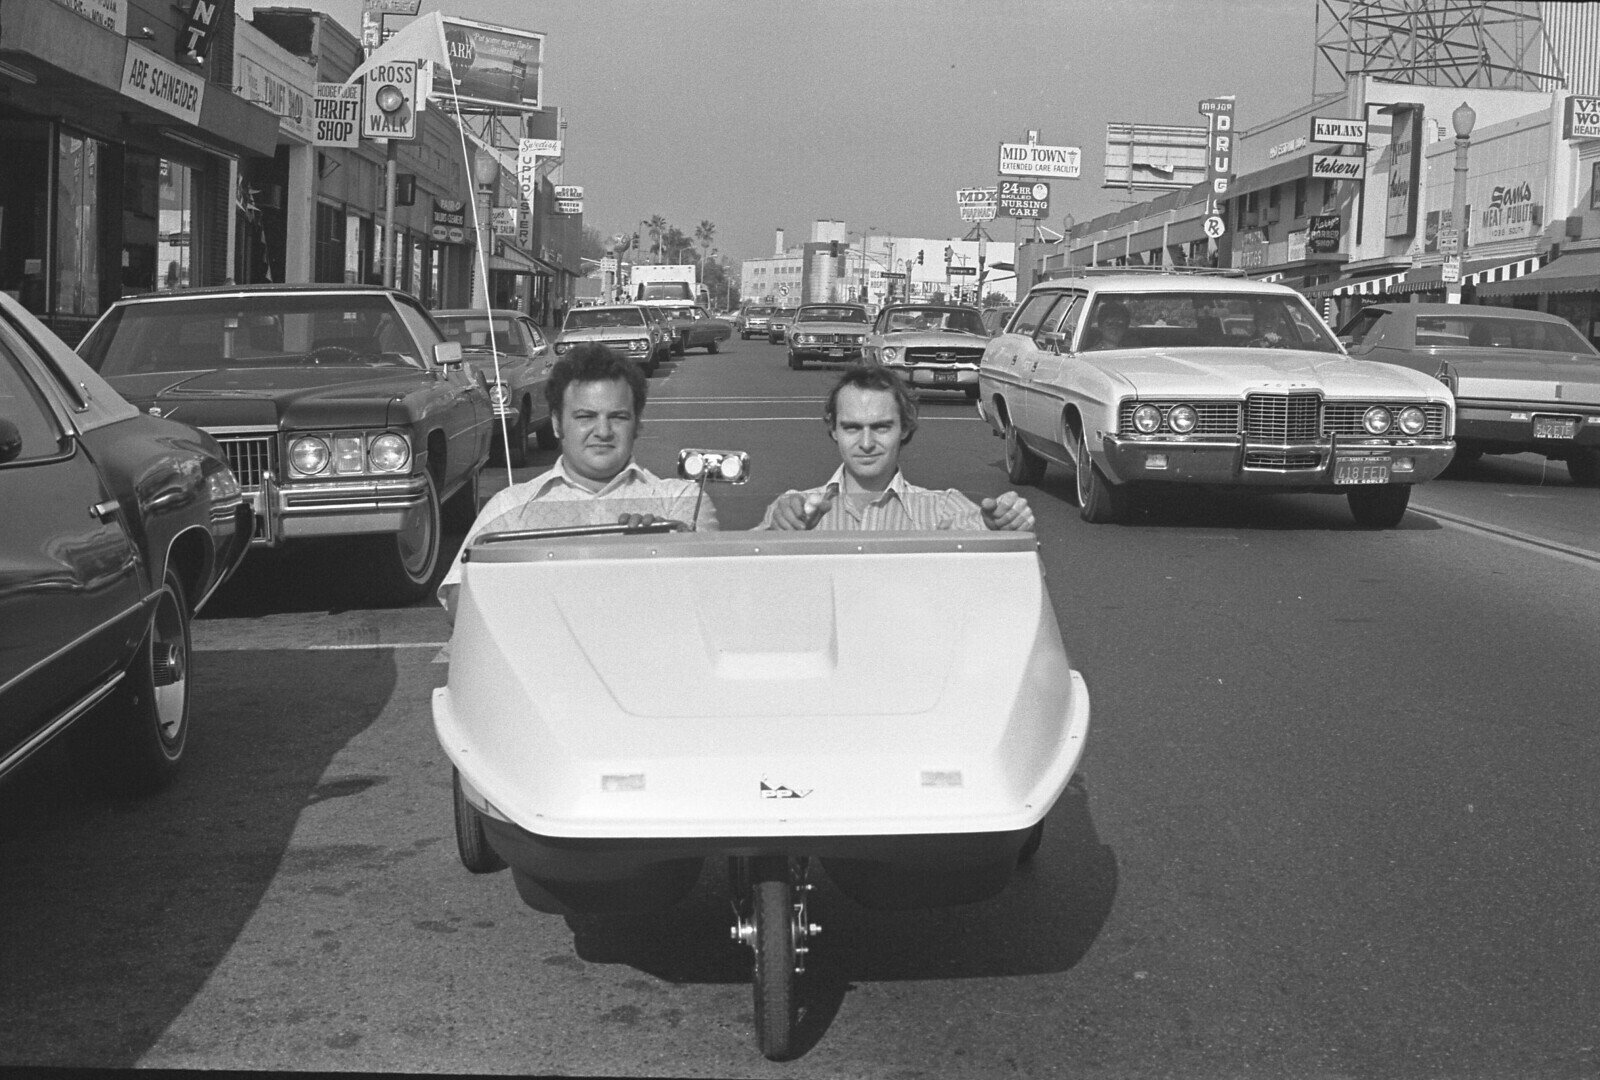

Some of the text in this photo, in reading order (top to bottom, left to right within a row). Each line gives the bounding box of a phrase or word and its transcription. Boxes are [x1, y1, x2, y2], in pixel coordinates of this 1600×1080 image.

[128, 58, 150, 90] ABE
[370, 65, 413, 84] CROSS
[149, 67, 199, 113] SCHNEIDER
[317, 85, 338, 98] HODGE
[314, 98, 359, 121] THRIFT
[1201, 102, 1233, 112] MAJOR
[317, 120, 354, 142] SHOP
[370, 114, 407, 133] WALK
[521, 140, 558, 153] Swedish
[1002, 147, 1067, 163] MID TOWN
[1002, 162, 1079, 174] EXTENDED CARE FACILITY
[1212, 115, 1231, 215] DRUGS
[1314, 156, 1361, 178] bakery
[959, 191, 998, 203] MDX
[1002, 182, 1032, 195] 24 HR
[1489, 180, 1532, 209] Sam's
[519, 156, 533, 247] UPHOLSTERY
[1001, 200, 1048, 209] NURSING
[961, 207, 996, 218] PHARMACY
[1009, 208, 1039, 217] CARE
[1482, 208, 1503, 228] MEAT
[1338, 466, 1387, 480] 418 FED
